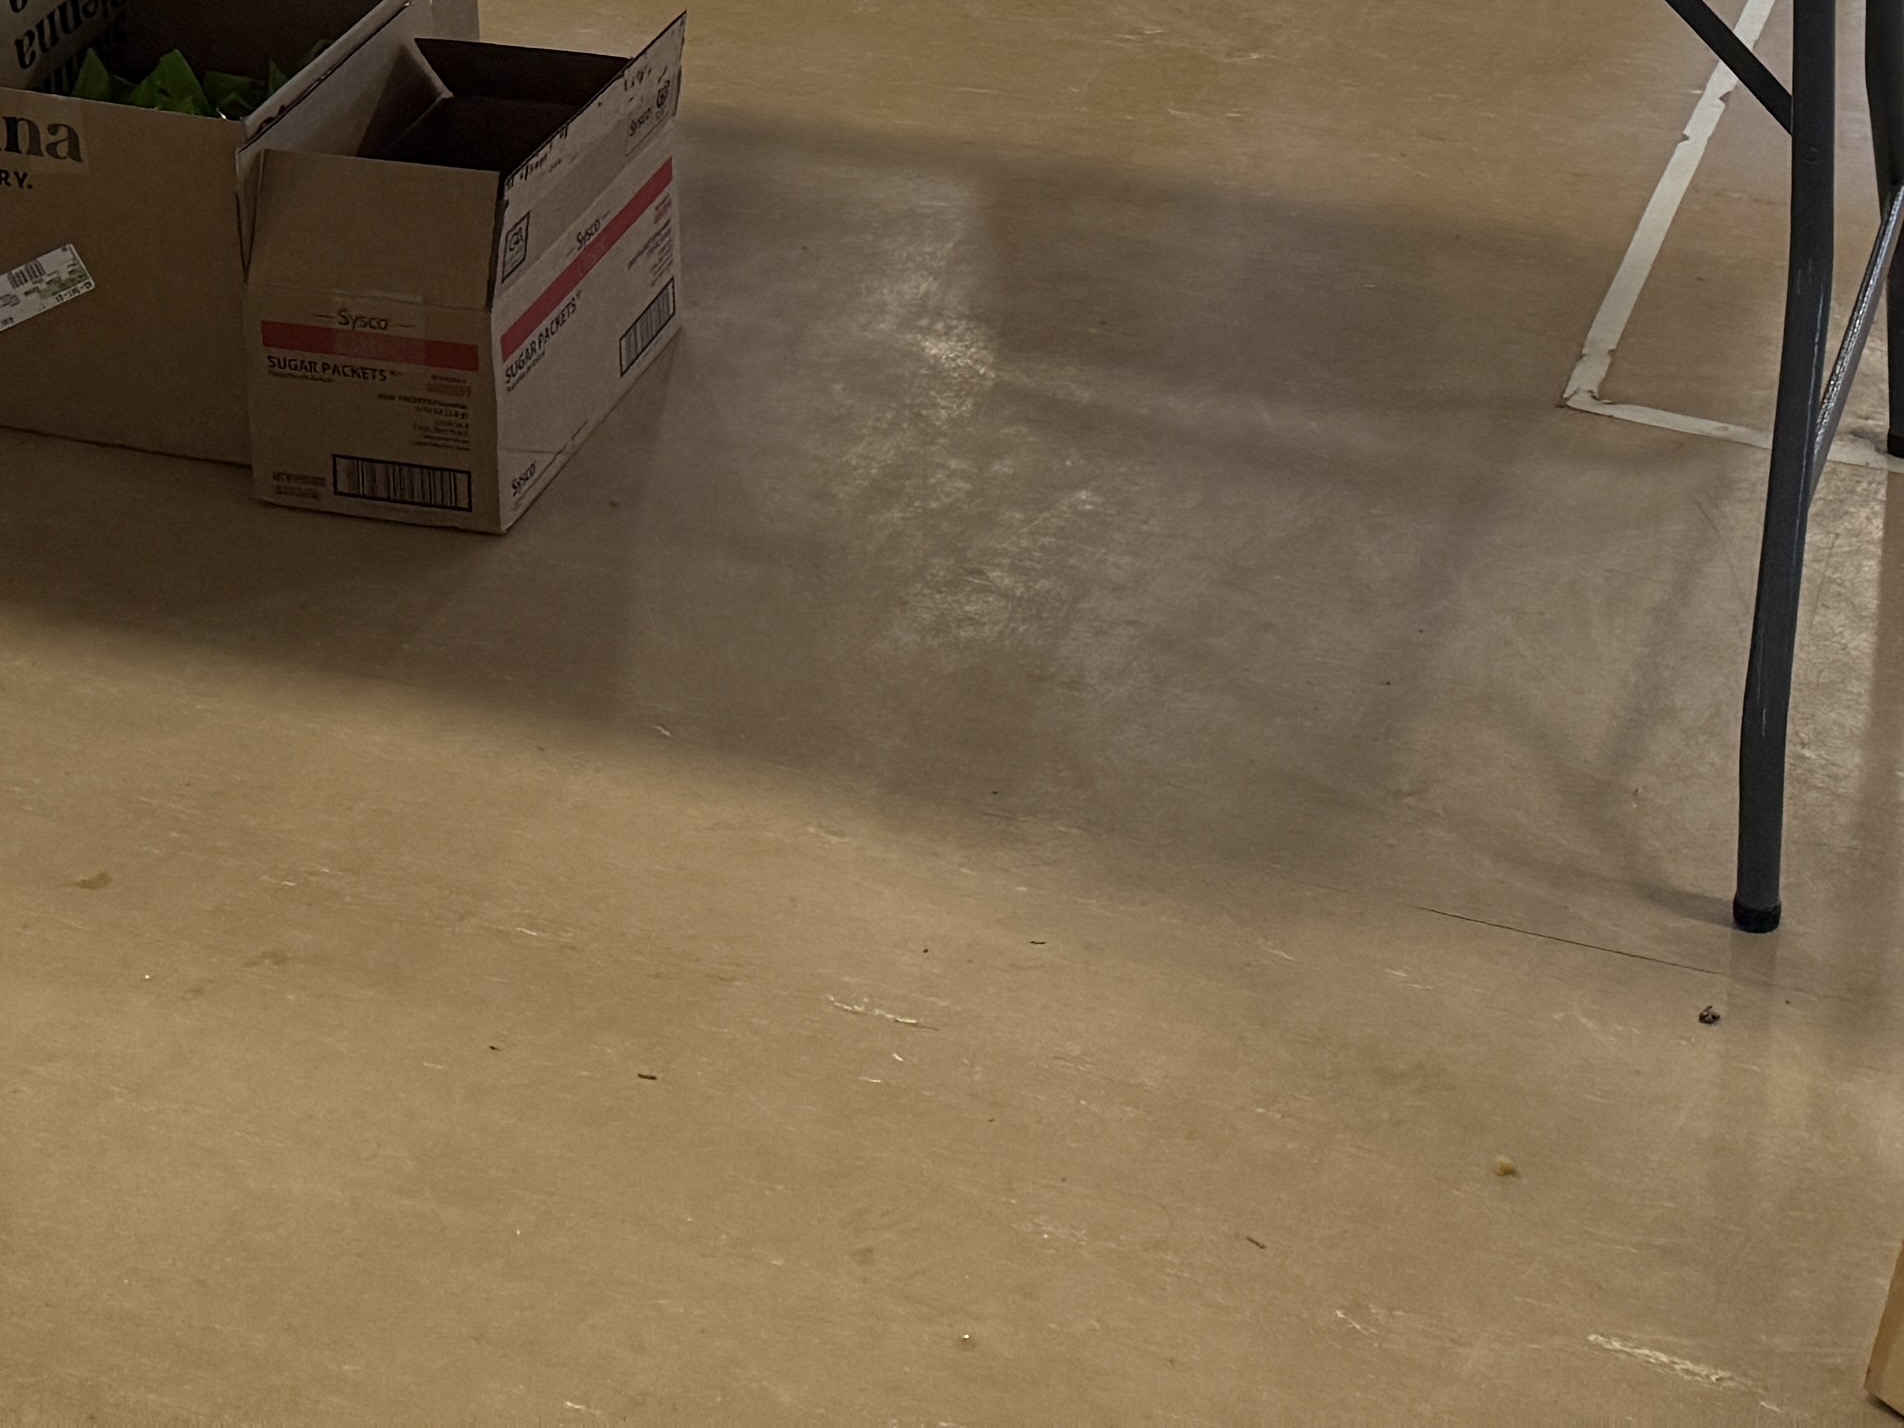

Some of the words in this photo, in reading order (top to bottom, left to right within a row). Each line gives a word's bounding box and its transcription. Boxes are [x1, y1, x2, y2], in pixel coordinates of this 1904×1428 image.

[575, 217, 602, 252] Sysco
[337, 308, 389, 331] Sysco
[504, 344, 538, 384] SUGAR
[537, 299, 578, 350] PACKETS
[266, 355, 318, 374] SUGAR
[321, 362, 388, 382] PACKETS
[510, 460, 537, 498] Sysco
